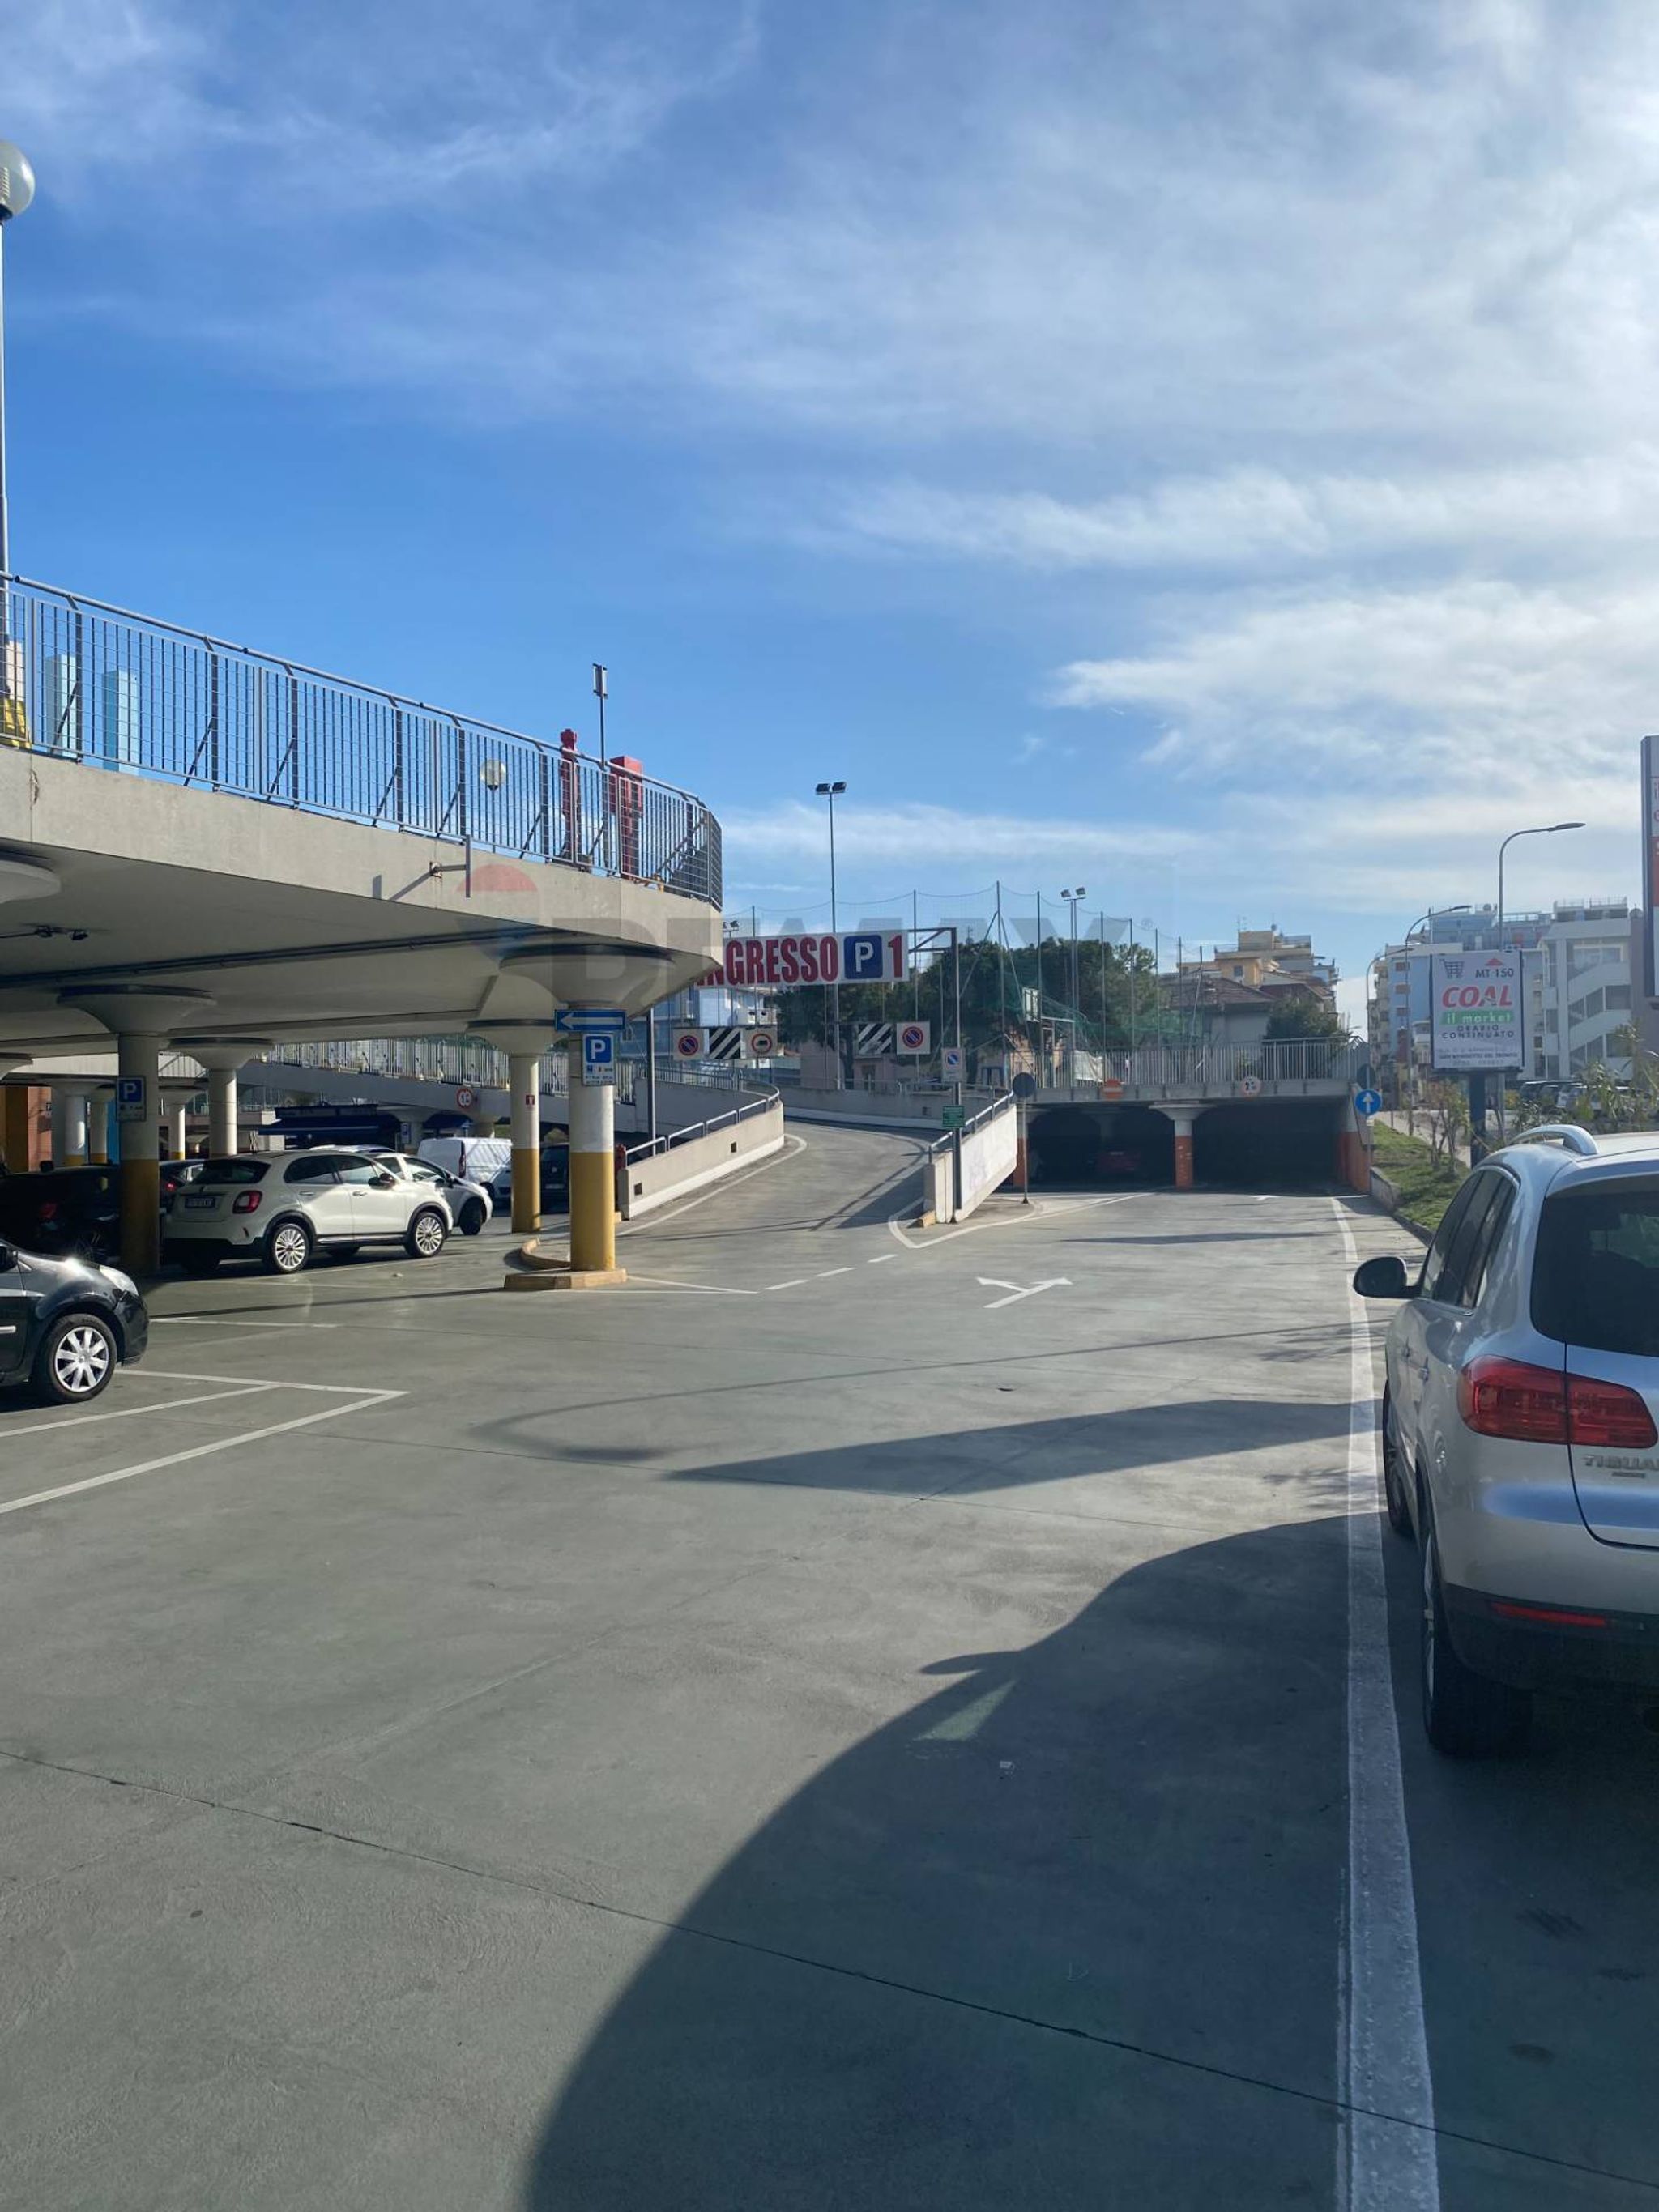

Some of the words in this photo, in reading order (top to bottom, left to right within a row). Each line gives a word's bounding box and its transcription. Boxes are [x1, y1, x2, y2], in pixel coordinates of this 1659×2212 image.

[697, 936, 839, 987] GRESSO
[855, 942, 874, 973] P
[888, 935, 903, 978] 1
[1475, 969, 1491, 978] MT
[1495, 968, 1514, 978] 150
[1442, 985, 1513, 1008] COAL
[1447, 1012, 1456, 1025] il
[1462, 1012, 1511, 1024] market
[591, 1039, 607, 1060] P
[123, 1082, 137, 1100] P
